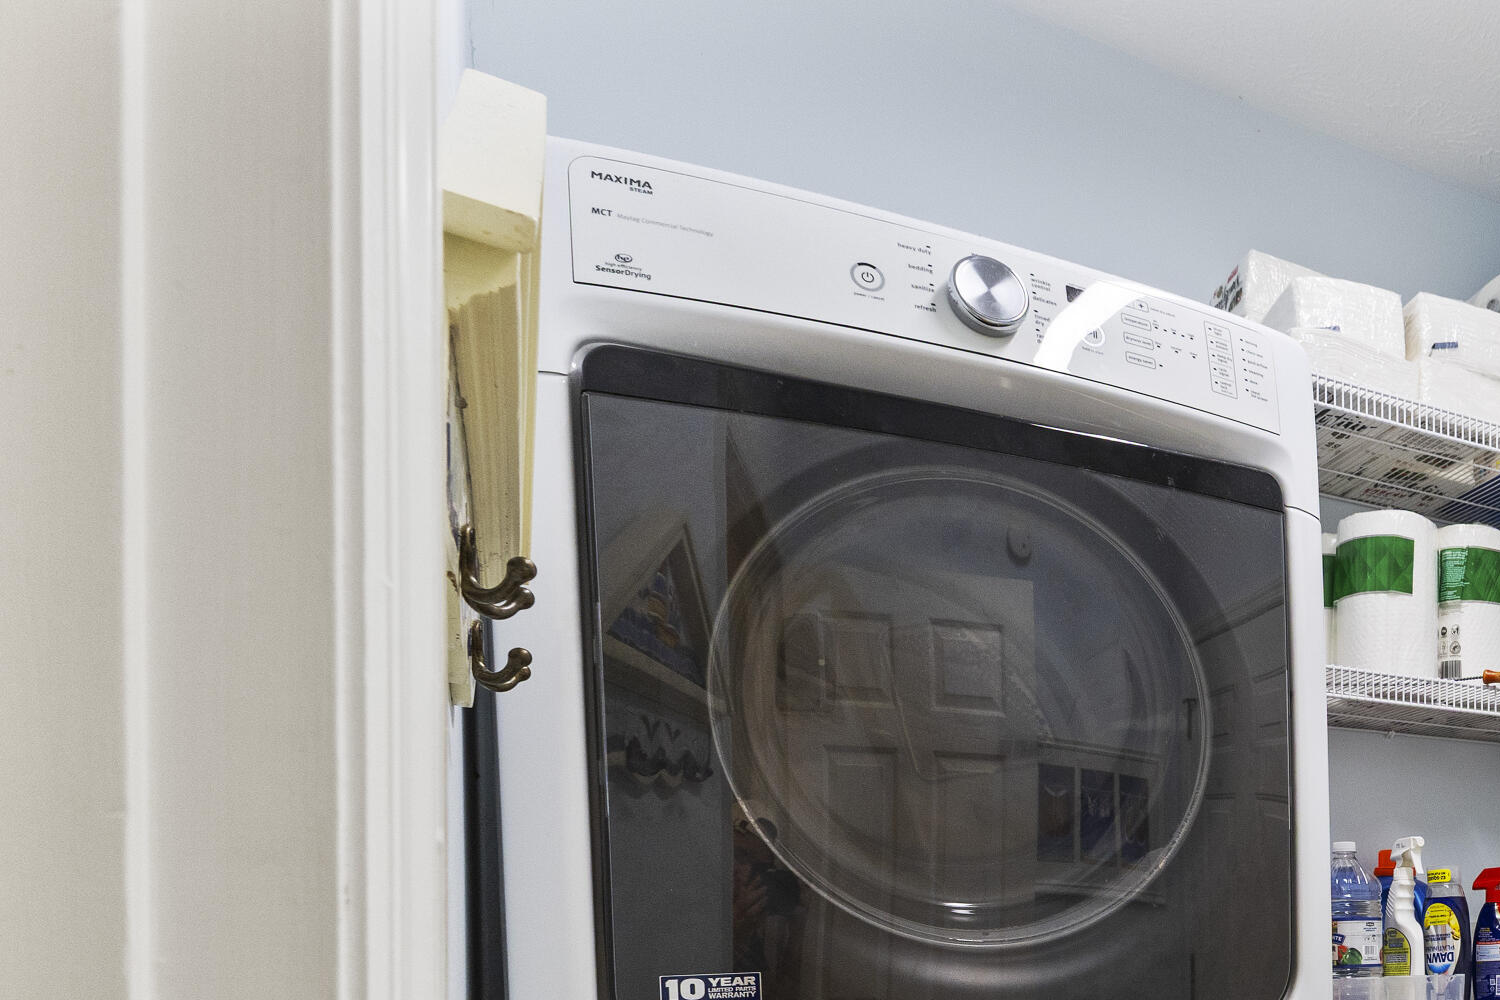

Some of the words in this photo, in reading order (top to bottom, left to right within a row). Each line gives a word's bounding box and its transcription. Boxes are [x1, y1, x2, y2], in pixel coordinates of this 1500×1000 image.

[591, 171, 652, 190] MAXIMA
[629, 187, 653, 195] STEAM
[591, 207, 613, 217] MCT
[897, 242, 916, 252] heavy
[595, 265, 652, 280] SensorDrying
[908, 264, 933, 274] bedding
[911, 285, 935, 293] sanitize
[1032, 297, 1057, 306] delicates
[1427, 952, 1455, 963] DAWN
[708, 976, 756, 987] YEAR
[665, 978, 705, 1000] 10
[708, 991, 756, 1000] WARRANTY
